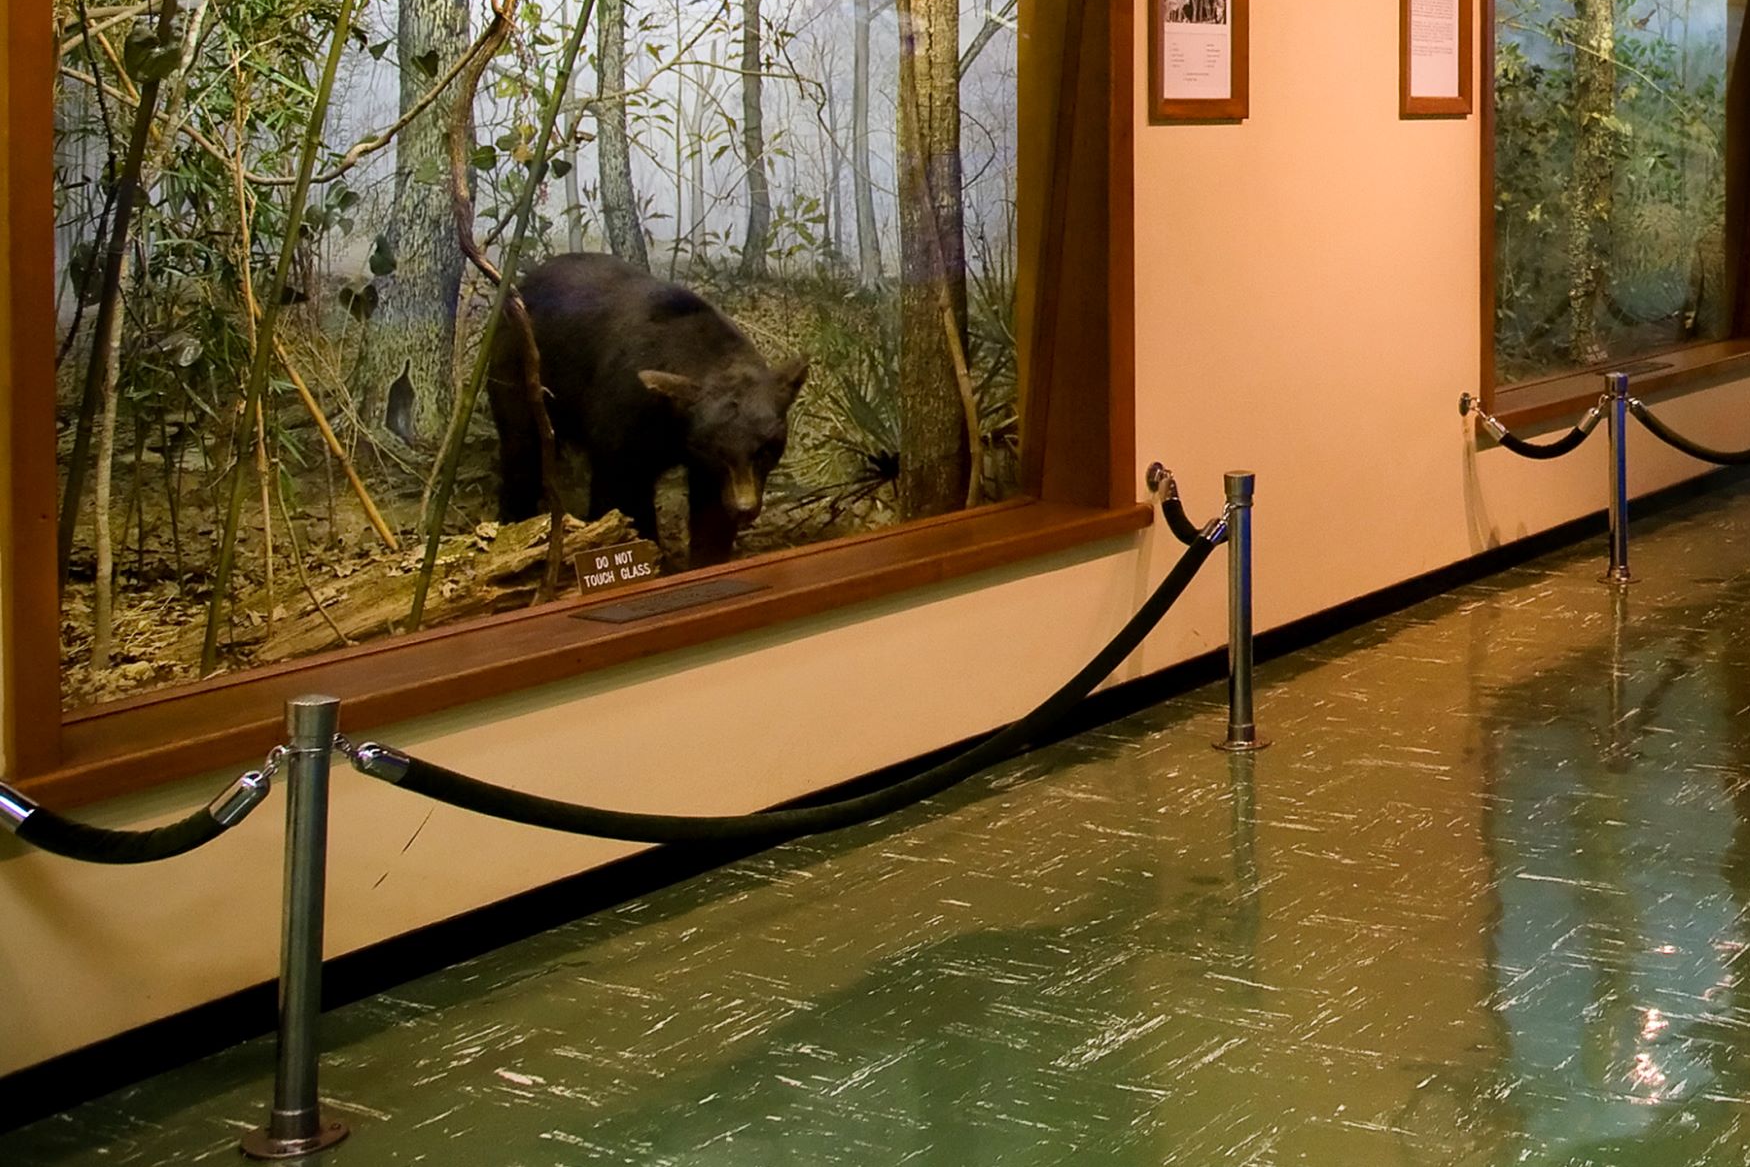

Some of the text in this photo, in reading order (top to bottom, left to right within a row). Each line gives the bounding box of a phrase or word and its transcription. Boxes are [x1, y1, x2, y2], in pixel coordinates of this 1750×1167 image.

[595, 550, 633, 569] DO NOT
[583, 563, 651, 588] TOUCH GLASS
